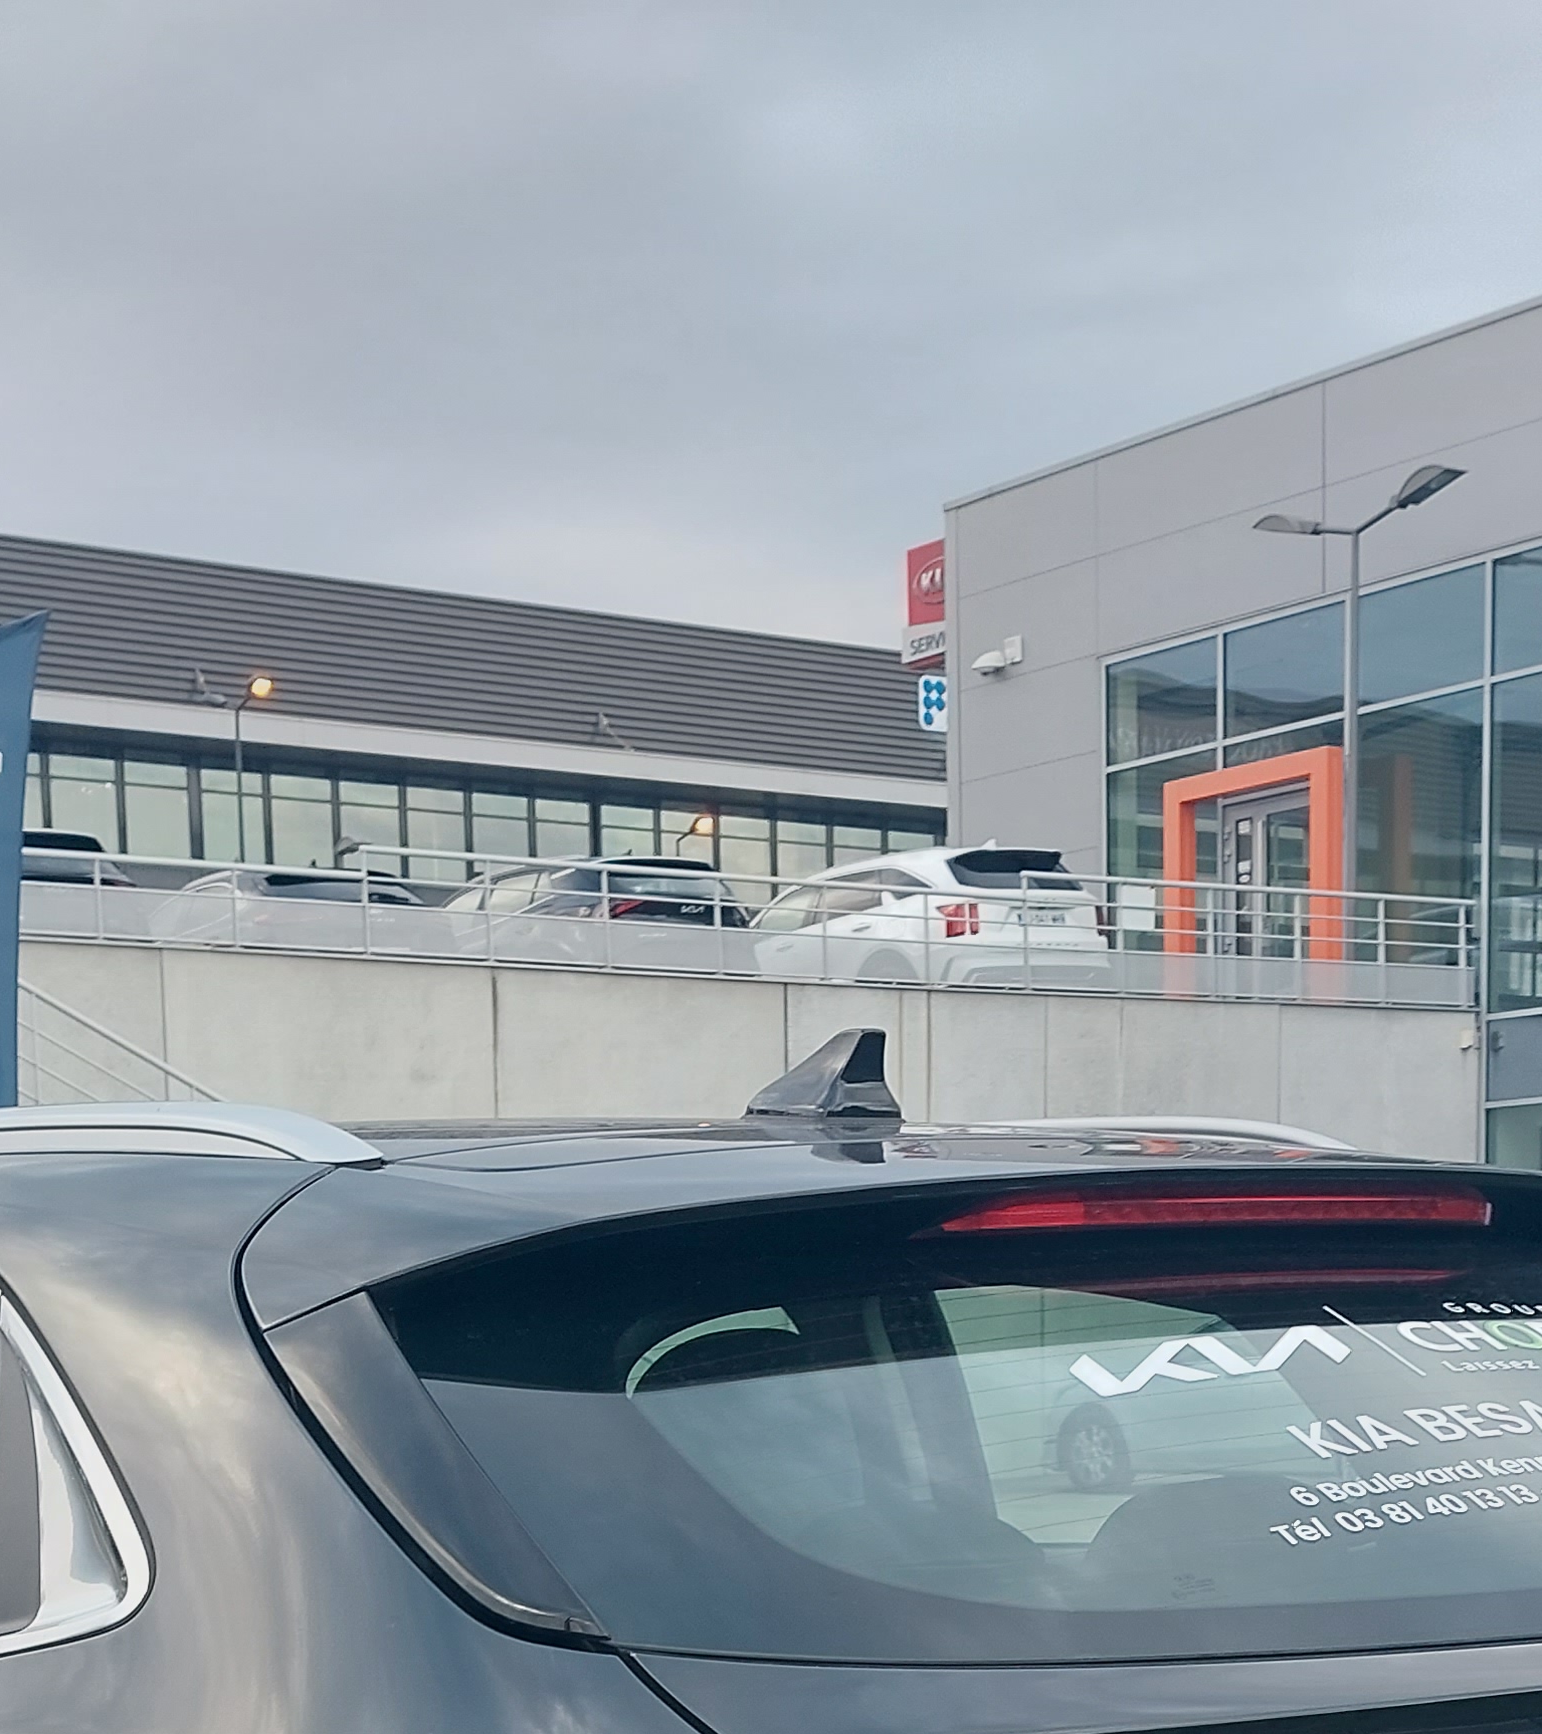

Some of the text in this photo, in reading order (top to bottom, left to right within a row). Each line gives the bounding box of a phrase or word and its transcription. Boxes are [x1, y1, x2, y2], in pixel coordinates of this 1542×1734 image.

[1069, 1325, 1351, 1398] KIA
[1442, 1358, 1540, 1374] Laissez
[1286, 1415, 1420, 1459] KIA
[1289, 1485, 1320, 1506] 6
[1315, 1460, 1484, 1502] Boulevard
[1269, 1517, 1332, 1546] Tél
[1335, 1508, 1385, 1533] 03
[1380, 1500, 1425, 1524] 81
[1426, 1493, 1469, 1516] 40
[1462, 1487, 1506, 1510] 13
[1498, 1483, 1540, 1504] 13
